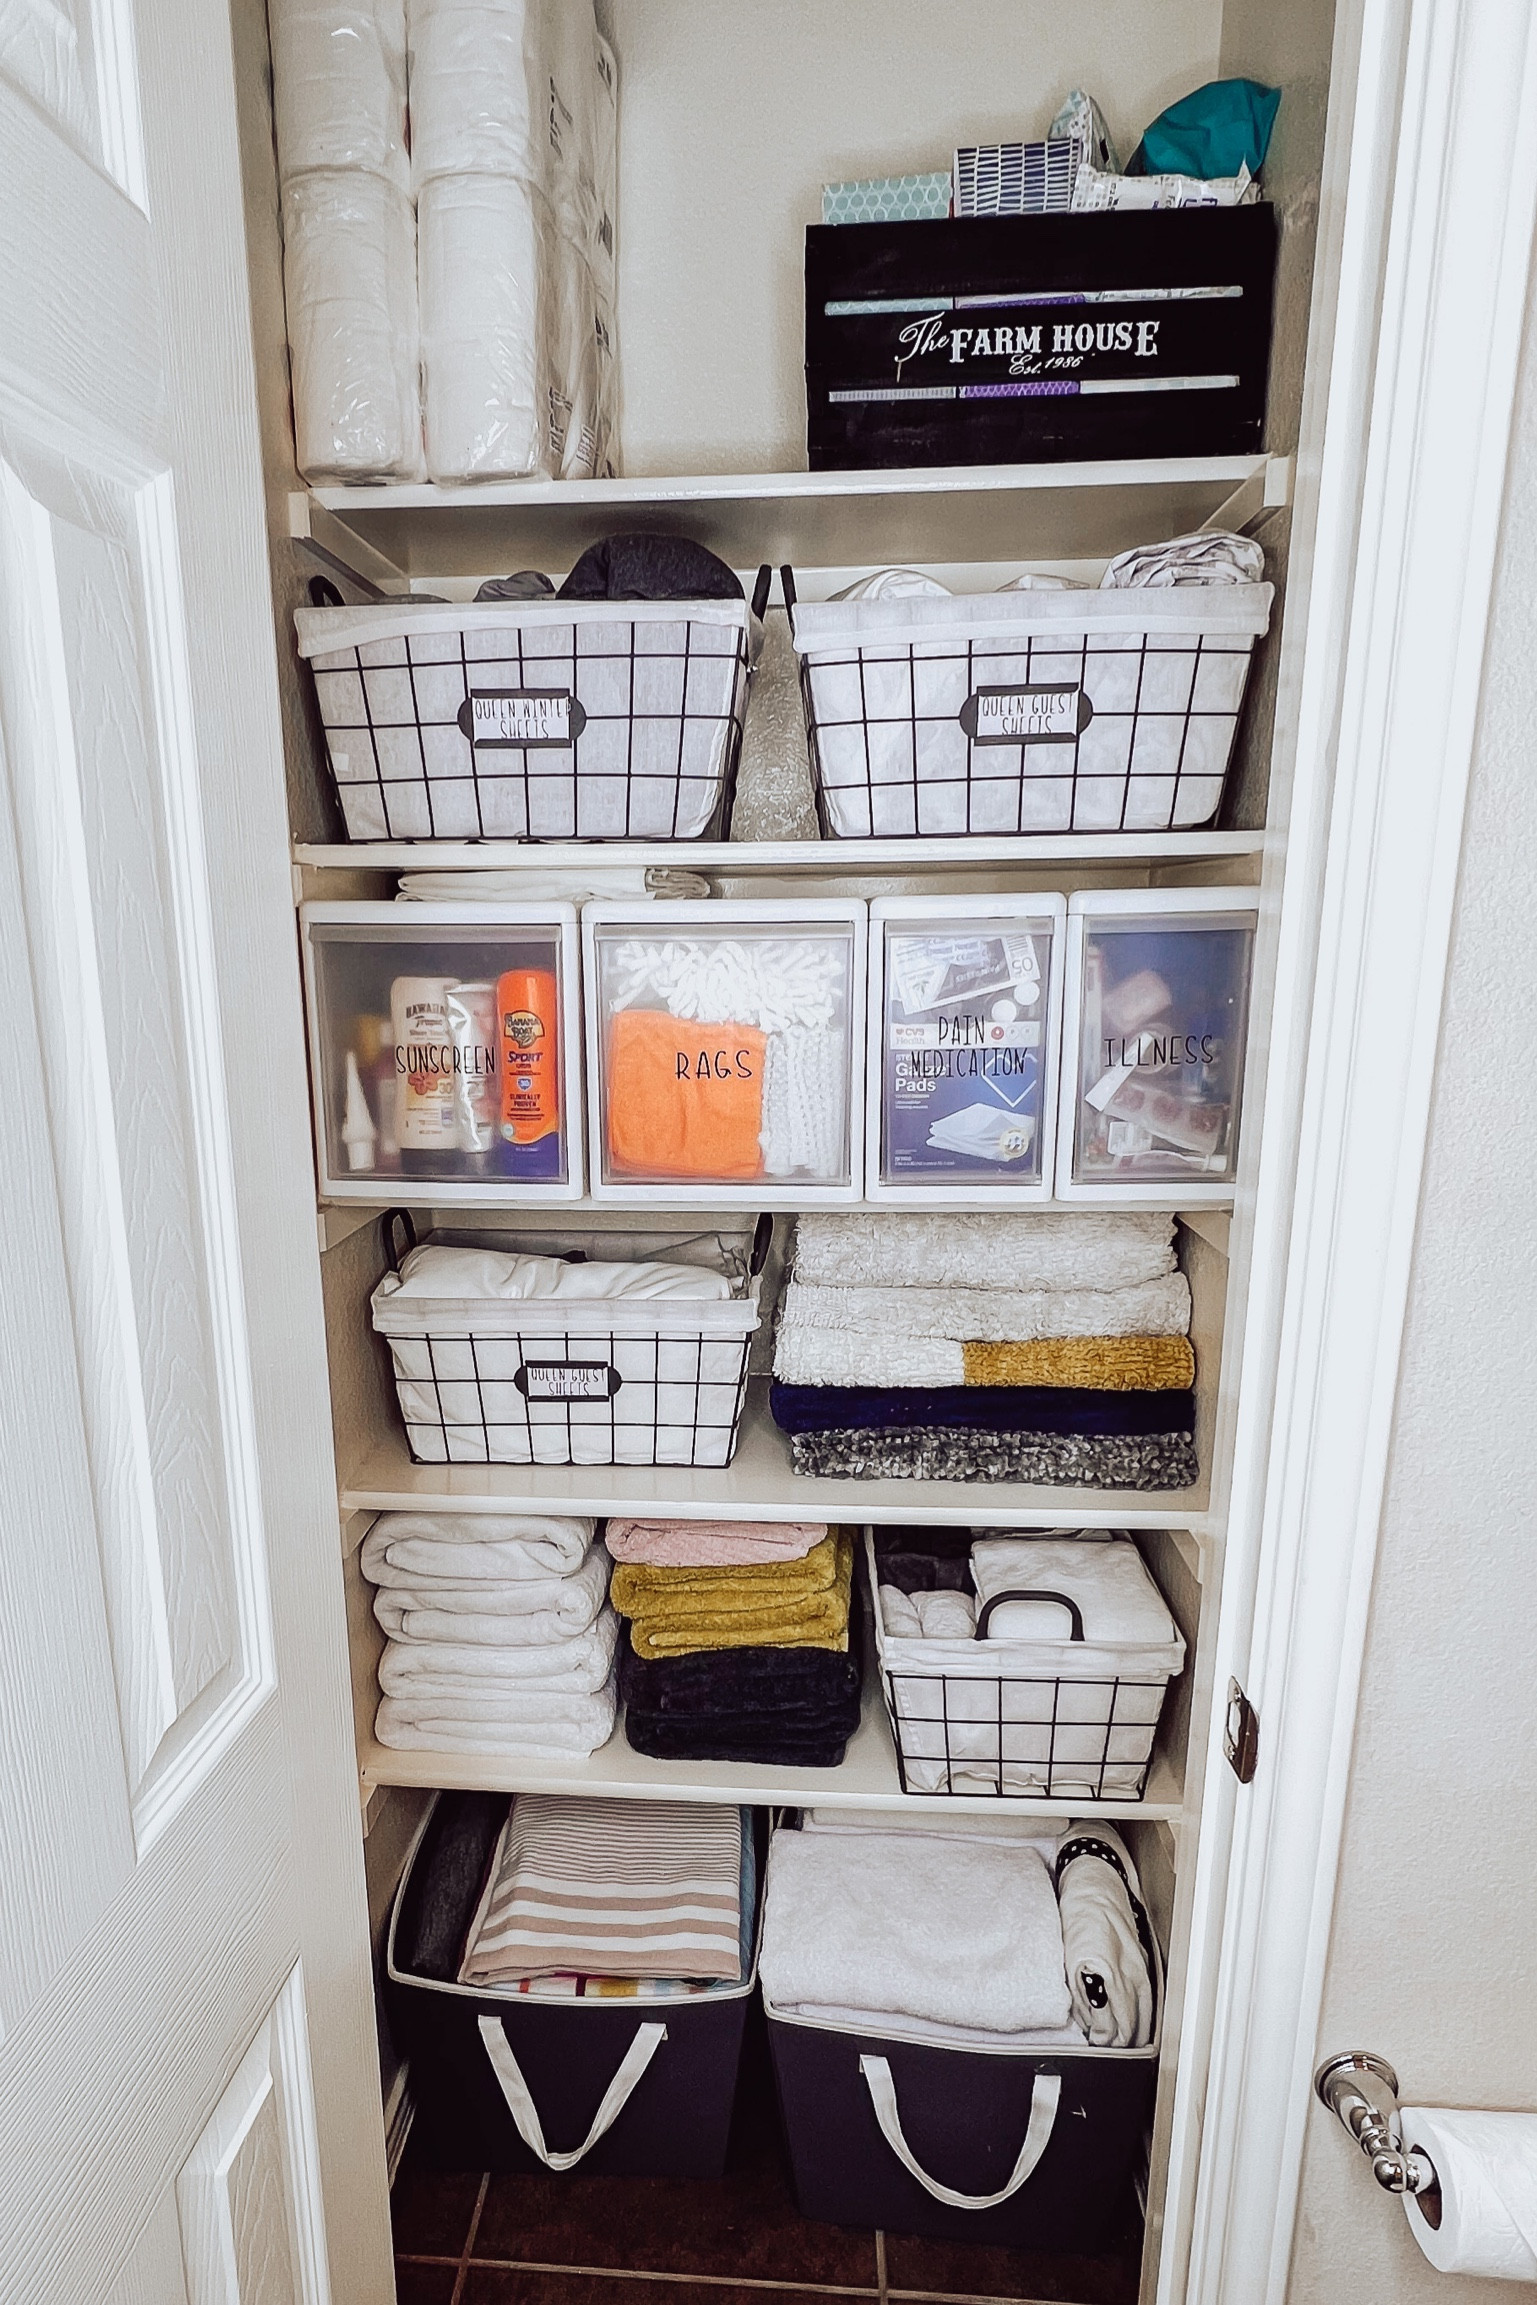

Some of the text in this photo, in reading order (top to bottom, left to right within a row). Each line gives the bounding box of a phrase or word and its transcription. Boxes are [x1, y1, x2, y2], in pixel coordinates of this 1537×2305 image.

[894, 311, 1161, 364] The FARM HOUSE
[1008, 354, 1084, 375] Est. 1986
[475, 699, 516, 720] QUEEN
[982, 693, 1074, 717] QUEEN GUEST
[501, 719, 549, 739] SHEETS
[1002, 715, 1052, 736] SHEETS
[938, 1015, 985, 1046] PAIN
[396, 1045, 496, 1074] SUNSCREEN
[1103, 1035, 1214, 1068] ILLNESS
[675, 1050, 752, 1080] RAGS
[911, 1047, 1028, 1079] MEDICATION
[895, 1078, 937, 1092] Pads
[531, 1368, 565, 1382] QUEEN
[548, 1381, 590, 1396] SHEETS
